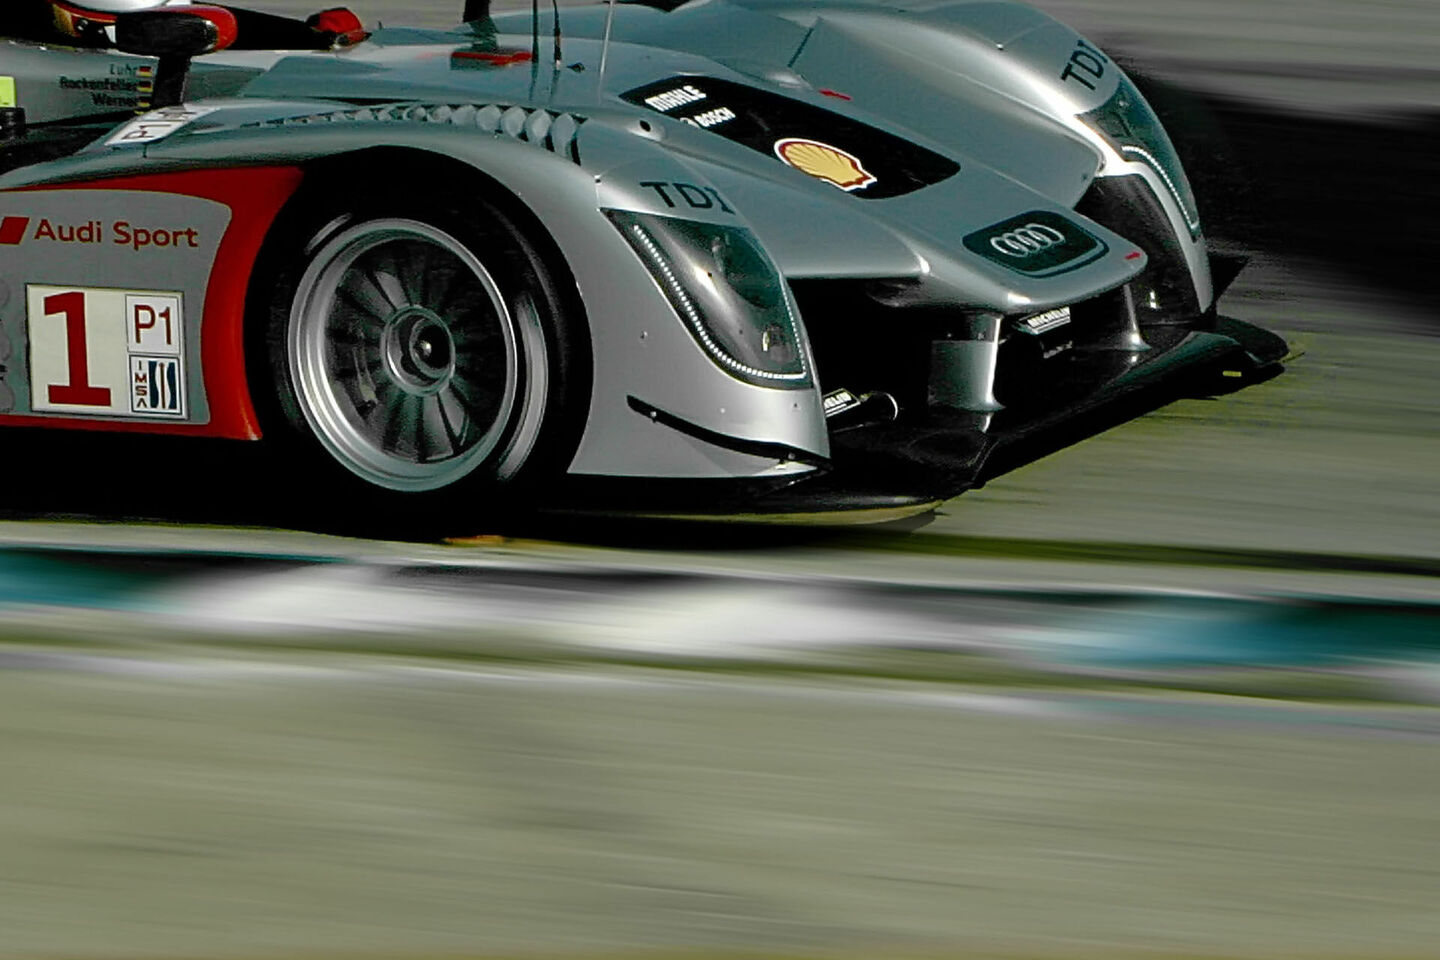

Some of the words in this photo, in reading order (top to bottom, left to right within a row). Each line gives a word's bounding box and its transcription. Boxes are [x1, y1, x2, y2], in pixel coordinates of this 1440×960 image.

[1061, 40, 1108, 90] TDI
[644, 85, 707, 113] MAHLE
[639, 182, 737, 215] TDI
[34, 218, 103, 243] Audi
[112, 221, 199, 252] Sport
[134, 304, 172, 345] P1
[44, 292, 112, 407] 1
